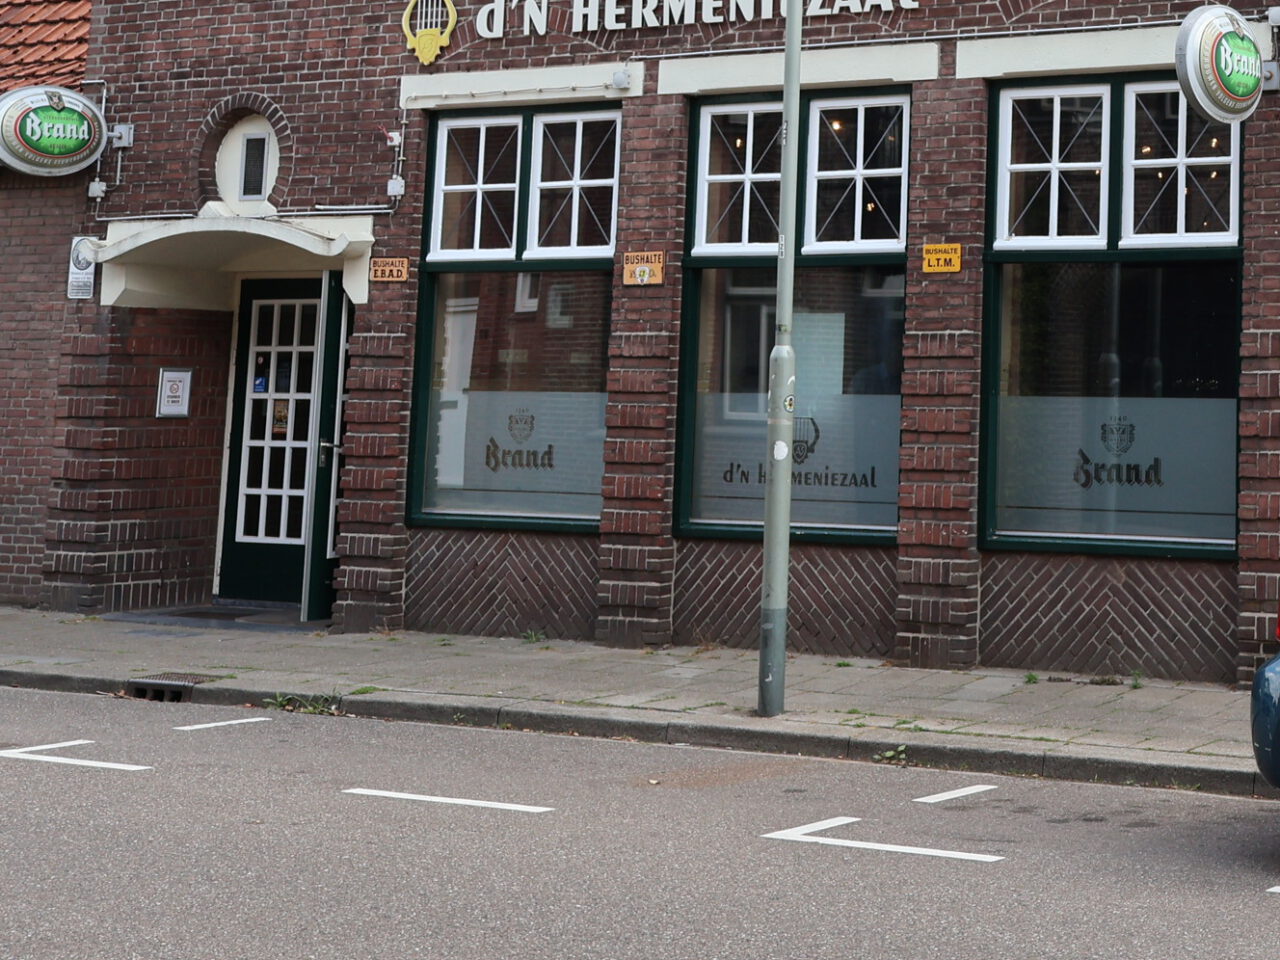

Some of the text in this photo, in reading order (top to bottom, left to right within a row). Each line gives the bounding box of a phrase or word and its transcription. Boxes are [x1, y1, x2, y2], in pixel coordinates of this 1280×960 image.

[1220, 38, 1261, 78] Brand
[26, 111, 90, 141] Brand
[624, 253, 662, 265] BUSHALTE
[924, 247, 958, 255] BUSHALTE
[372, 260, 405, 268] BUSHALTE
[927, 257, 955, 268] L.T.M.
[485, 436, 555, 473] Brand
[1073, 448, 1164, 490] Brand
